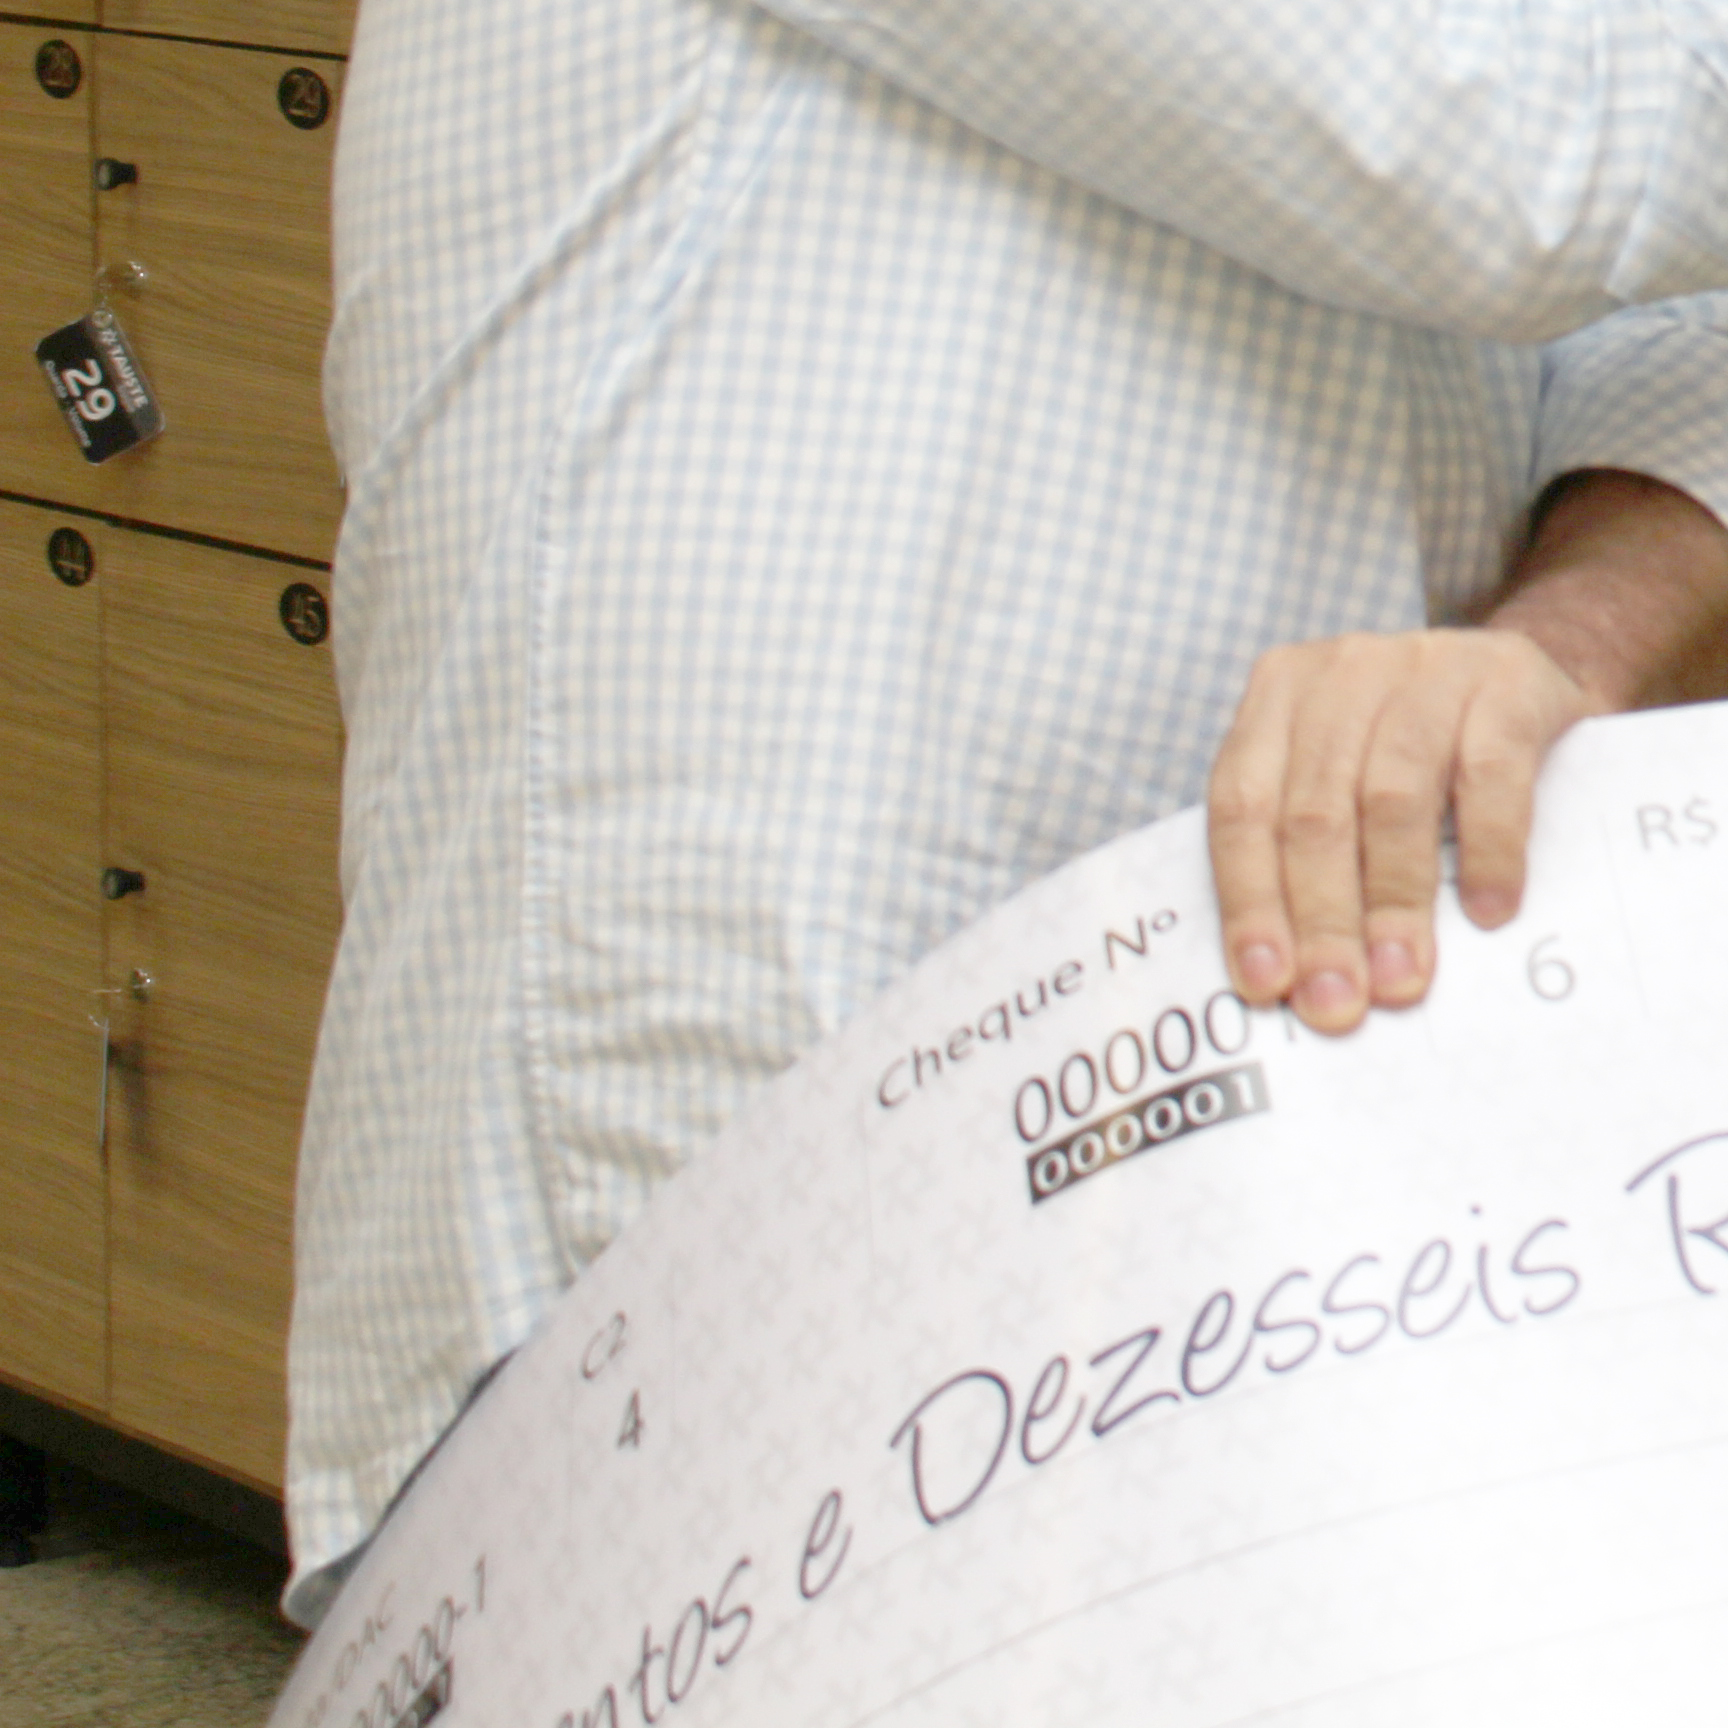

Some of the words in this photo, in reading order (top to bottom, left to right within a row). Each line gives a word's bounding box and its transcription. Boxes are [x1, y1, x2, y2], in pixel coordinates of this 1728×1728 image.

[60, 358, 116, 422] 29
[1525, 933, 1577, 1003] 6
[876, 960, 1084, 1109] Cheque
[1031, 1072, 1257, 1196] 000001
[799, 1488, 853, 1601] e
[888, 1202, 1582, 1528] Dezesseis
